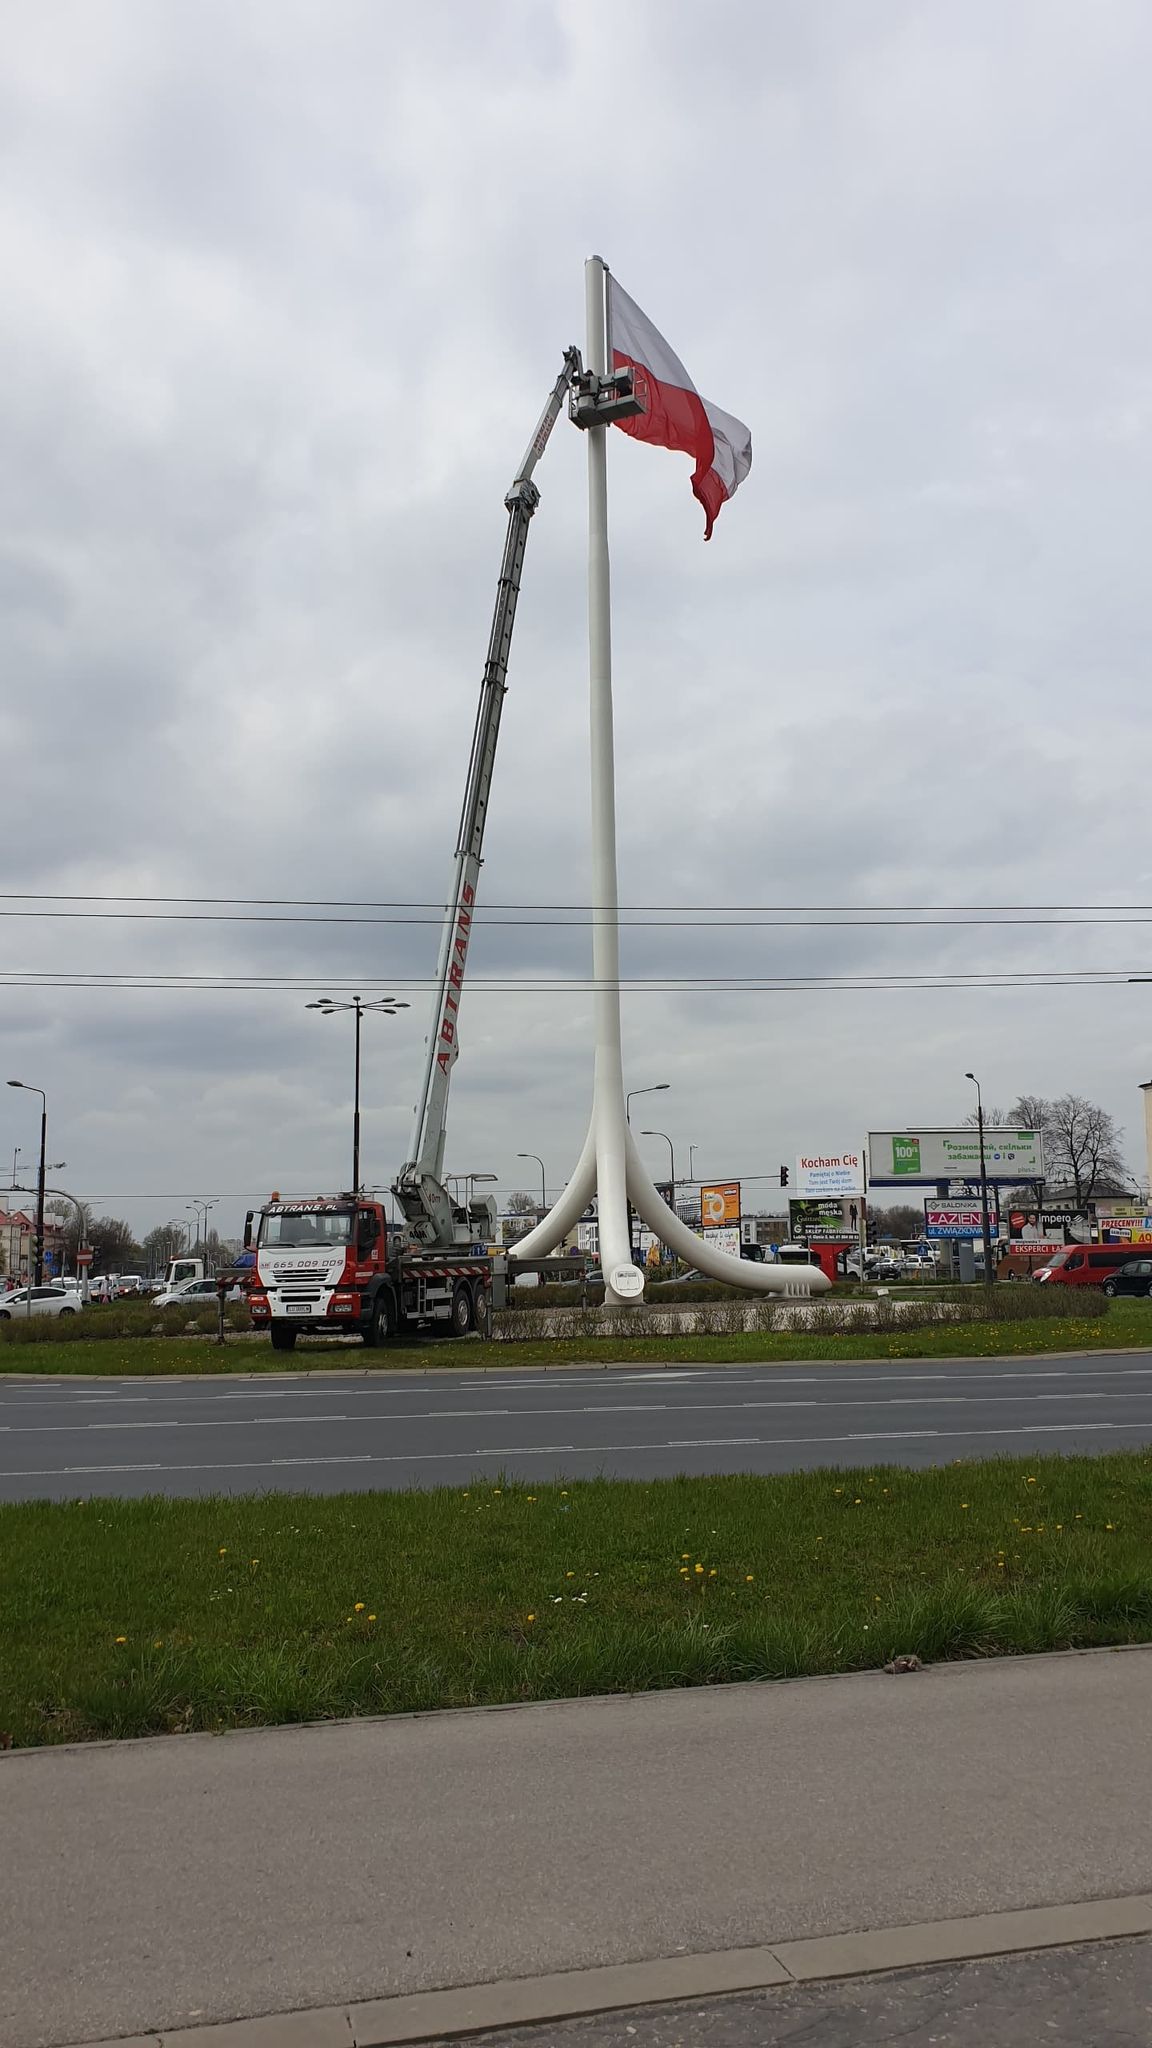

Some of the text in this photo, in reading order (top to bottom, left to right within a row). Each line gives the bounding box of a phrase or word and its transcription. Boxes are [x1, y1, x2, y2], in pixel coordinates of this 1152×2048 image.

[437, 881, 475, 1077] ABTRANS
[801, 1154, 858, 1169] Kocham Cię
[818, 1201, 838, 1209] moda
[819, 1208, 843, 1217] męska
[927, 1213, 995, 1225] ŁAZIENI
[1039, 1213, 1072, 1223] impero
[1101, 1218, 1143, 1228] PRZECENY!!!
[273, 1260, 294, 1269] 665
[297, 1260, 319, 1268] 009
[322, 1259, 344, 1268] 009
